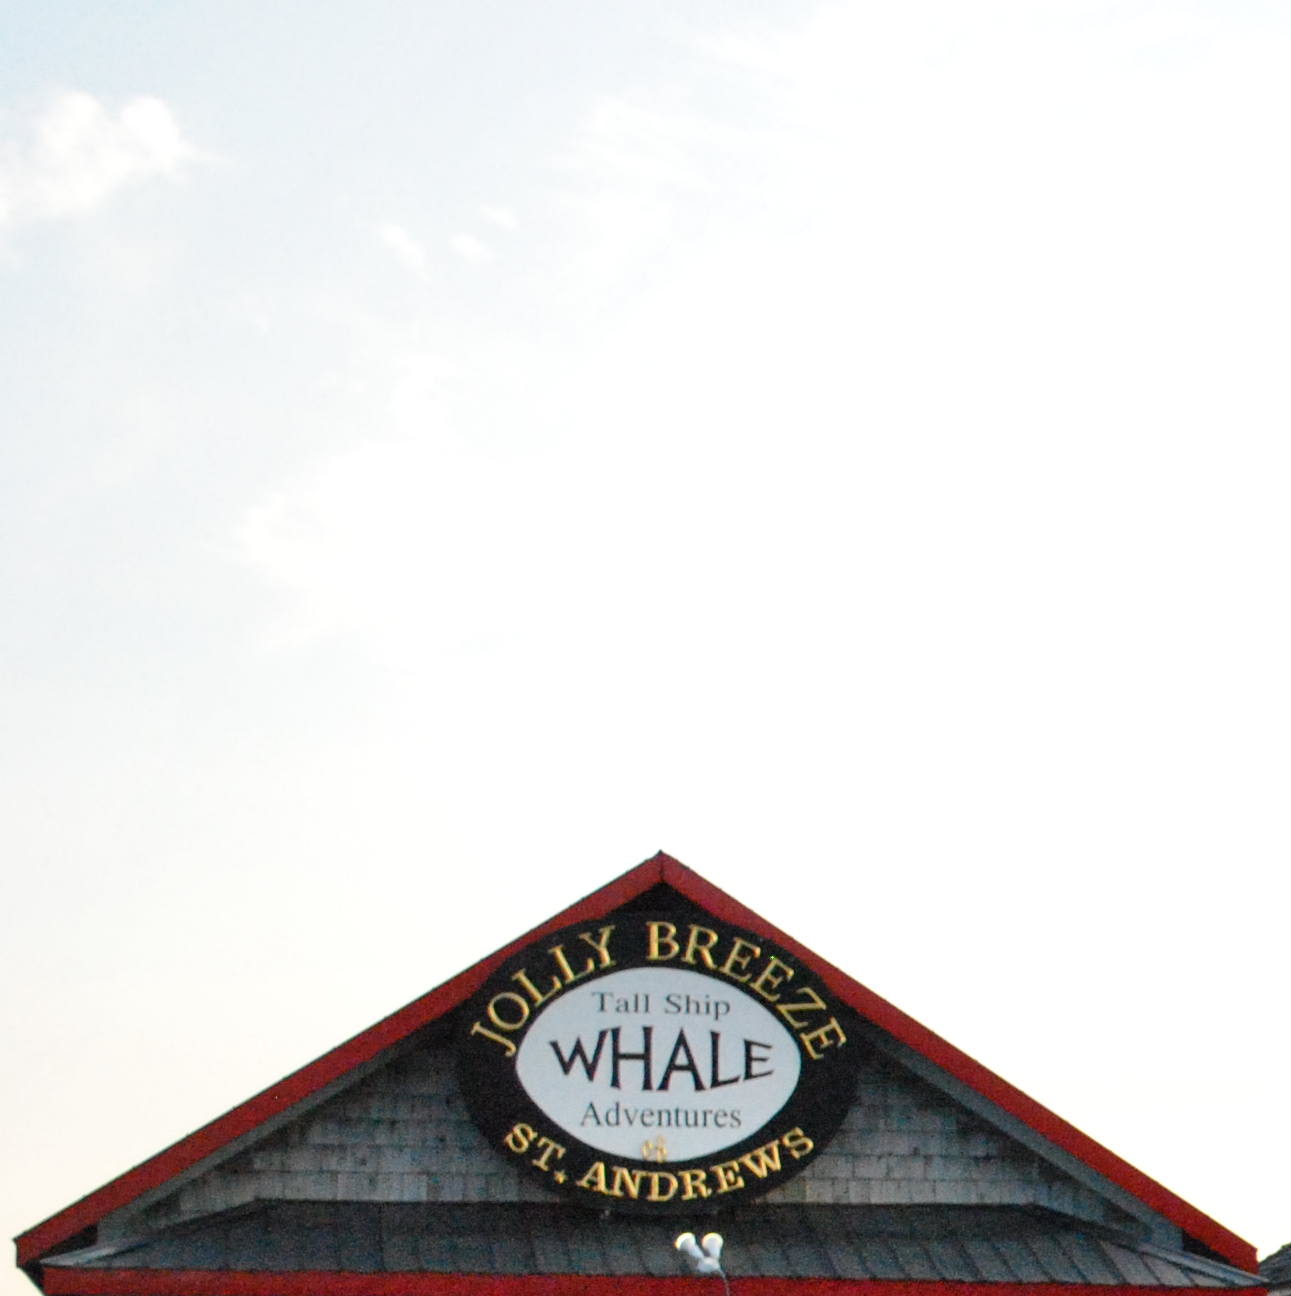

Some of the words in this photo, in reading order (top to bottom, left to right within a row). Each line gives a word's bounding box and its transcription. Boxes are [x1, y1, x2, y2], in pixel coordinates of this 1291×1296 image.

[470, 924, 617, 1058] JOLLY
[645, 920, 847, 1061] BREEZE
[590, 991, 651, 1015] Tall
[663, 992, 732, 1021] Ship
[548, 1025, 775, 1092] WHALE
[579, 1101, 743, 1129] Adventures
[576, 1126, 815, 1203] ANDREWS
